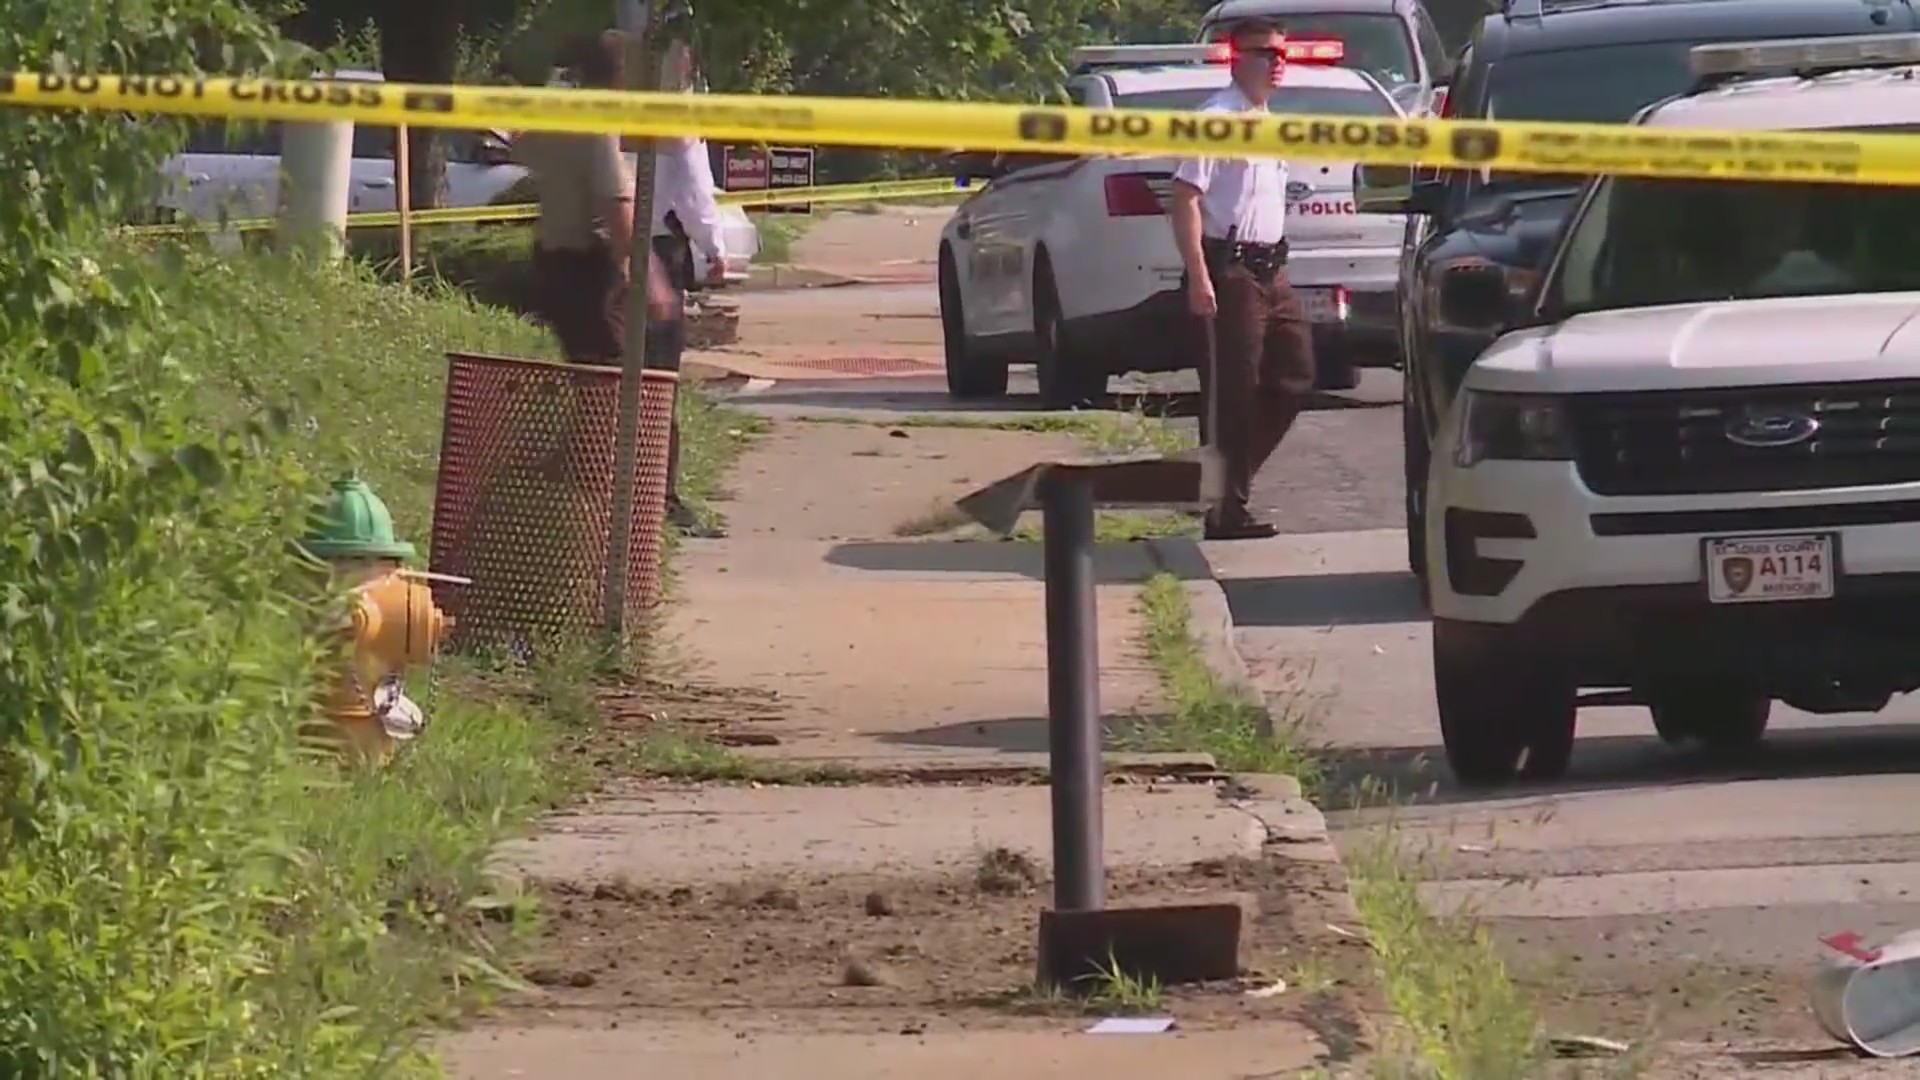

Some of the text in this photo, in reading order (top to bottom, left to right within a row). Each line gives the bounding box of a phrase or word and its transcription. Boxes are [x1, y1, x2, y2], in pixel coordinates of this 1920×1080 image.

[38, 75, 383, 108] DO NOT CROSS
[1090, 113, 1431, 147] DO NOT CROSS
[1299, 201, 1355, 215] POLIC
[1775, 540, 1823, 553] COUNTY
[1760, 554, 1822, 576] A114
